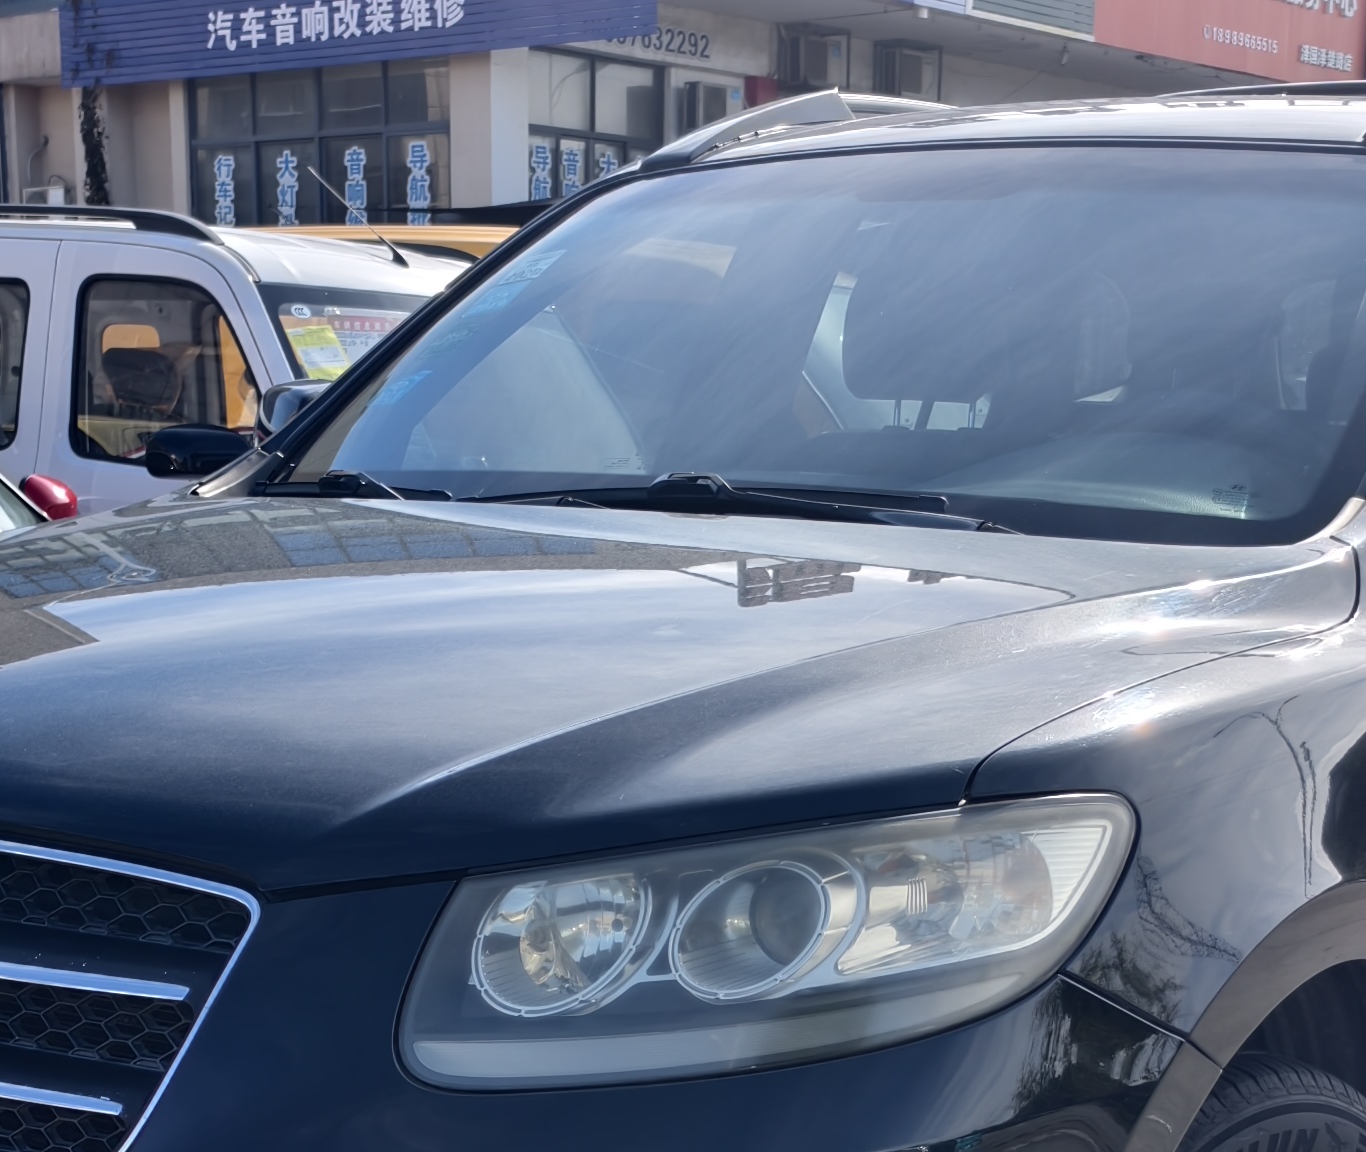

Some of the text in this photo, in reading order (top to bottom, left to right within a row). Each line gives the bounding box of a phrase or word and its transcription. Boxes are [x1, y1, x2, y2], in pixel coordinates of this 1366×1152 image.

[207, 0, 465, 50] 汽车音响改装维修
